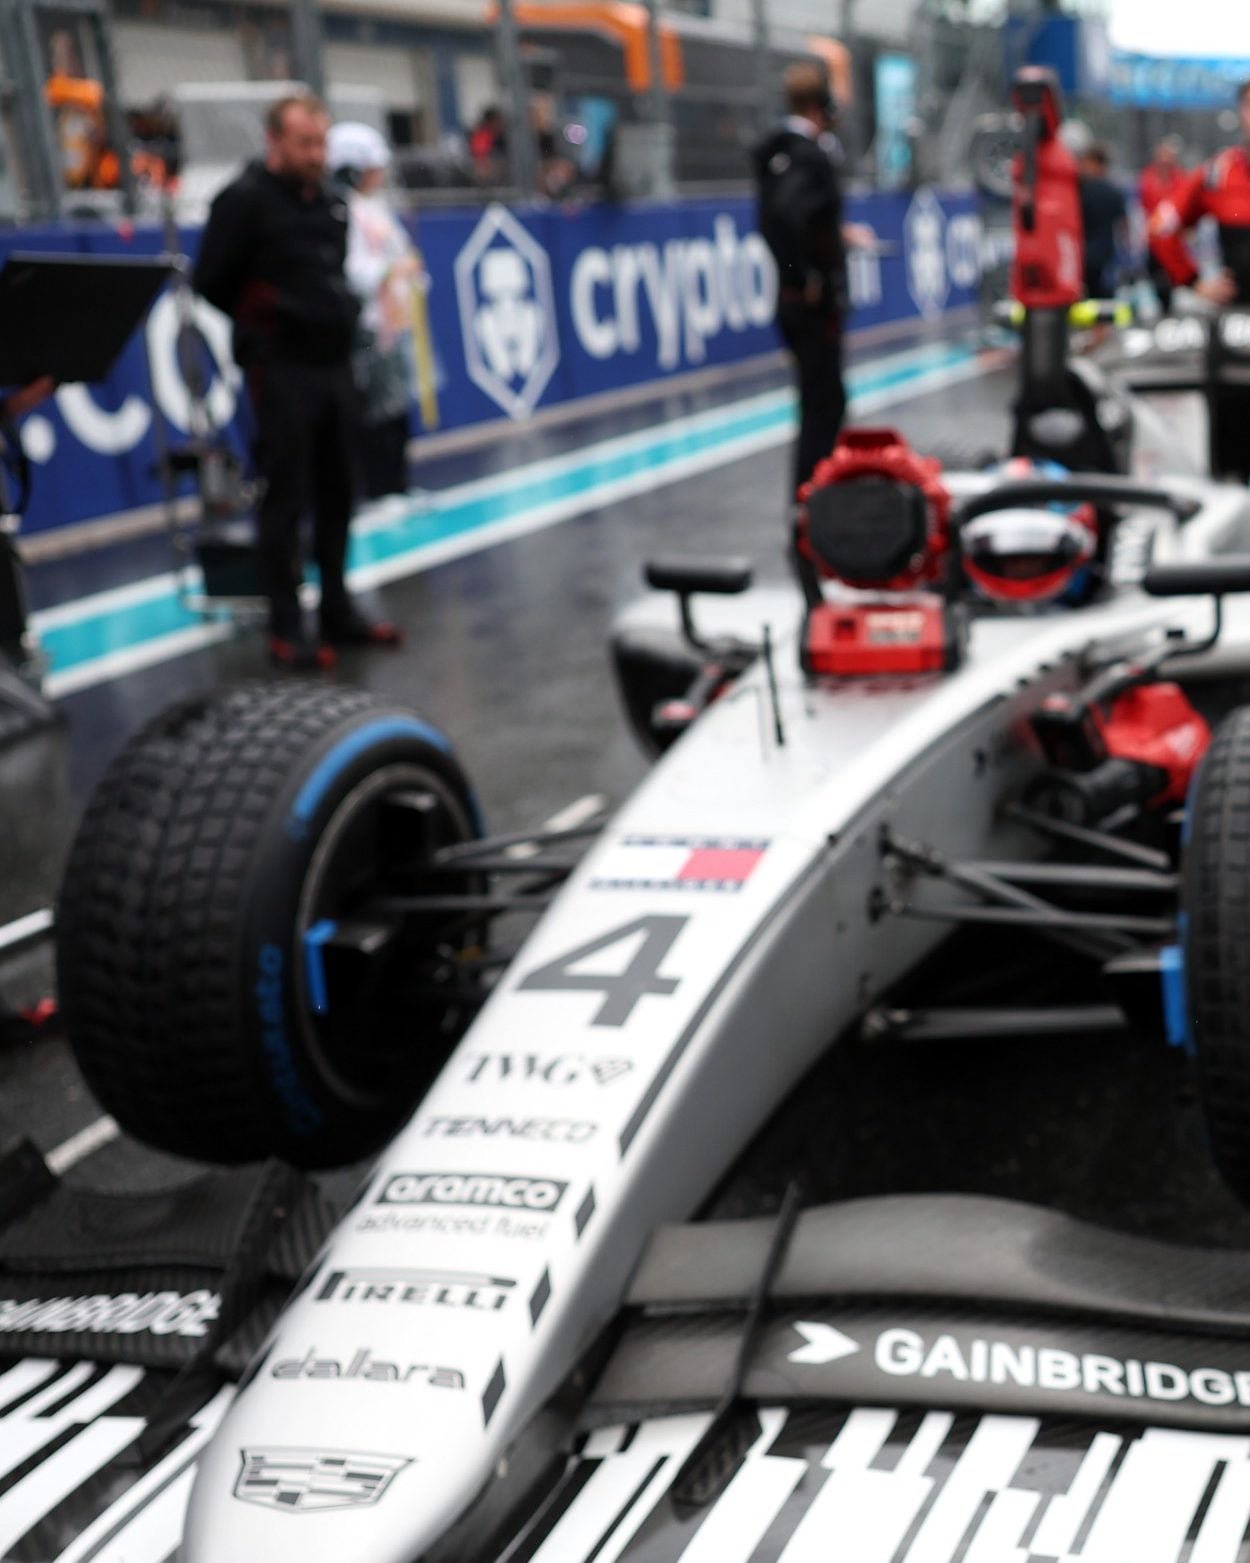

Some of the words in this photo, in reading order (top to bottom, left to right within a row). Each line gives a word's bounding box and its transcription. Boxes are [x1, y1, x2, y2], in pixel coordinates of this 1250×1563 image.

[511, 911, 695, 1029] 4
[463, 1052, 584, 1084] TWG
[423, 1114, 599, 1142] TENNECO
[384, 1174, 561, 1209] aramco
[353, 1210, 490, 1235] advanced
[493, 1213, 550, 1240] fuel
[316, 1268, 518, 1311] PIRELLI
[271, 1346, 465, 1390] dallara
